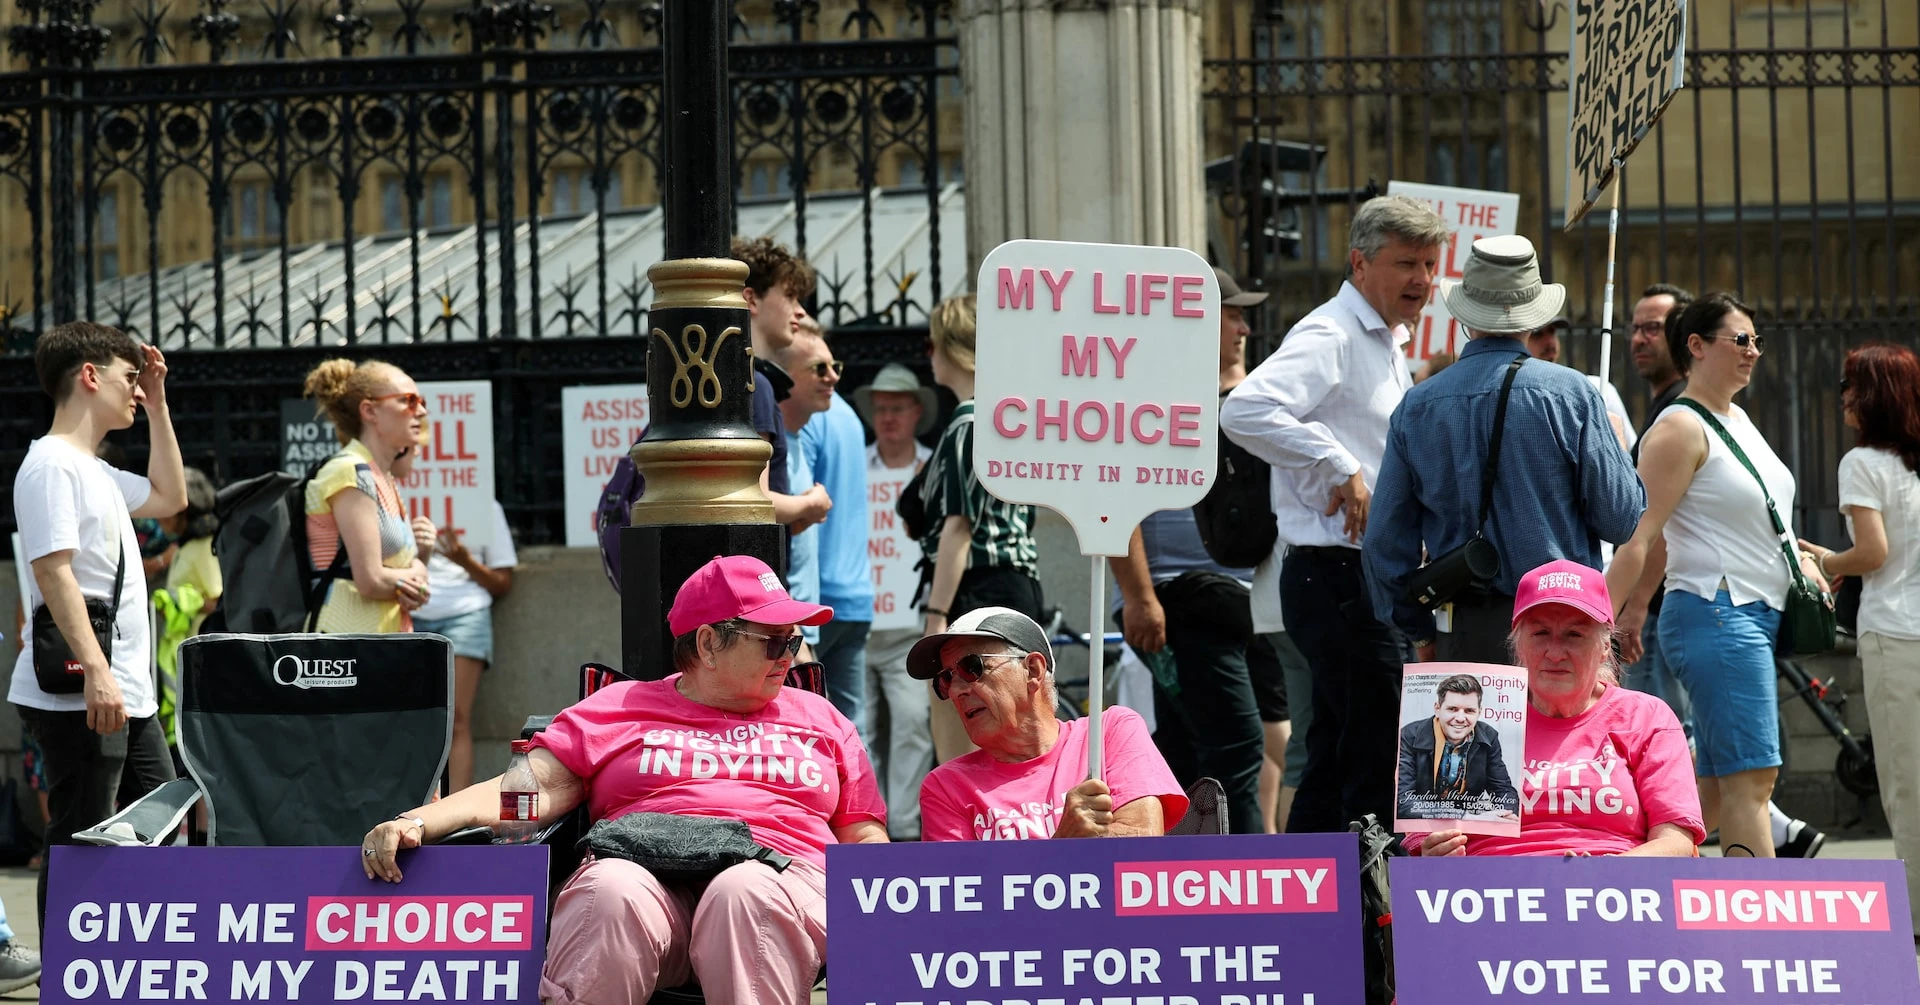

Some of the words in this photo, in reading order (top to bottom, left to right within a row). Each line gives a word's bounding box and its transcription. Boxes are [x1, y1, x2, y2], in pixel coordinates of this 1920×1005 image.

[1612, 66, 1671, 157] HELL
[1457, 202, 1499, 229] THE
[997, 267, 1075, 312] MY
[1093, 271, 1205, 319] LIFE
[1061, 335, 1138, 379] MY
[437, 393, 476, 414] THE
[582, 398, 649, 421] ASSIS
[286, 422, 319, 442] NO
[322, 421, 337, 440] T
[993, 397, 1202, 448] CHOICE
[592, 427, 621, 449] US
[439, 467, 478, 488] THE
[1098, 465, 1121, 483] IN
[1135, 466, 1205, 486] DYING
[873, 509, 895, 531] IN
[273, 654, 357, 689] QUEST
[1481, 675, 1526, 690] Dignity
[1498, 692, 1509, 703] in
[1484, 707, 1522, 722] Dying
[638, 748, 683, 777] IN
[691, 751, 830, 793] DYING.
[1523, 759, 1617, 788] NITY
[1400, 789, 1438, 805] Jordan
[1413, 801, 1455, 809] 20/08/1985
[1522, 786, 1634, 815] YING.
[851, 876, 983, 913] VOTE
[1002, 873, 1101, 911] FOR
[1121, 868, 1329, 908] DIGNITY
[1416, 889, 1547, 923] VOTE
[1565, 888, 1663, 922] FOR
[1680, 889, 1880, 924] DIGNITY
[68, 902, 197, 943] GIVE
[218, 903, 296, 943] ME
[315, 902, 524, 944] CHOICE
[62, 959, 209, 1001] OVER
[230, 959, 315, 1001] MY
[334, 959, 520, 1001] DEATH
[910, 950, 1044, 989] VOTE
[1063, 947, 1162, 986] FOR
[1180, 945, 1281, 984] THE
[1477, 959, 1612, 995] VOTE
[1627, 959, 1726, 994] FOR
[1742, 959, 1841, 994] THE
